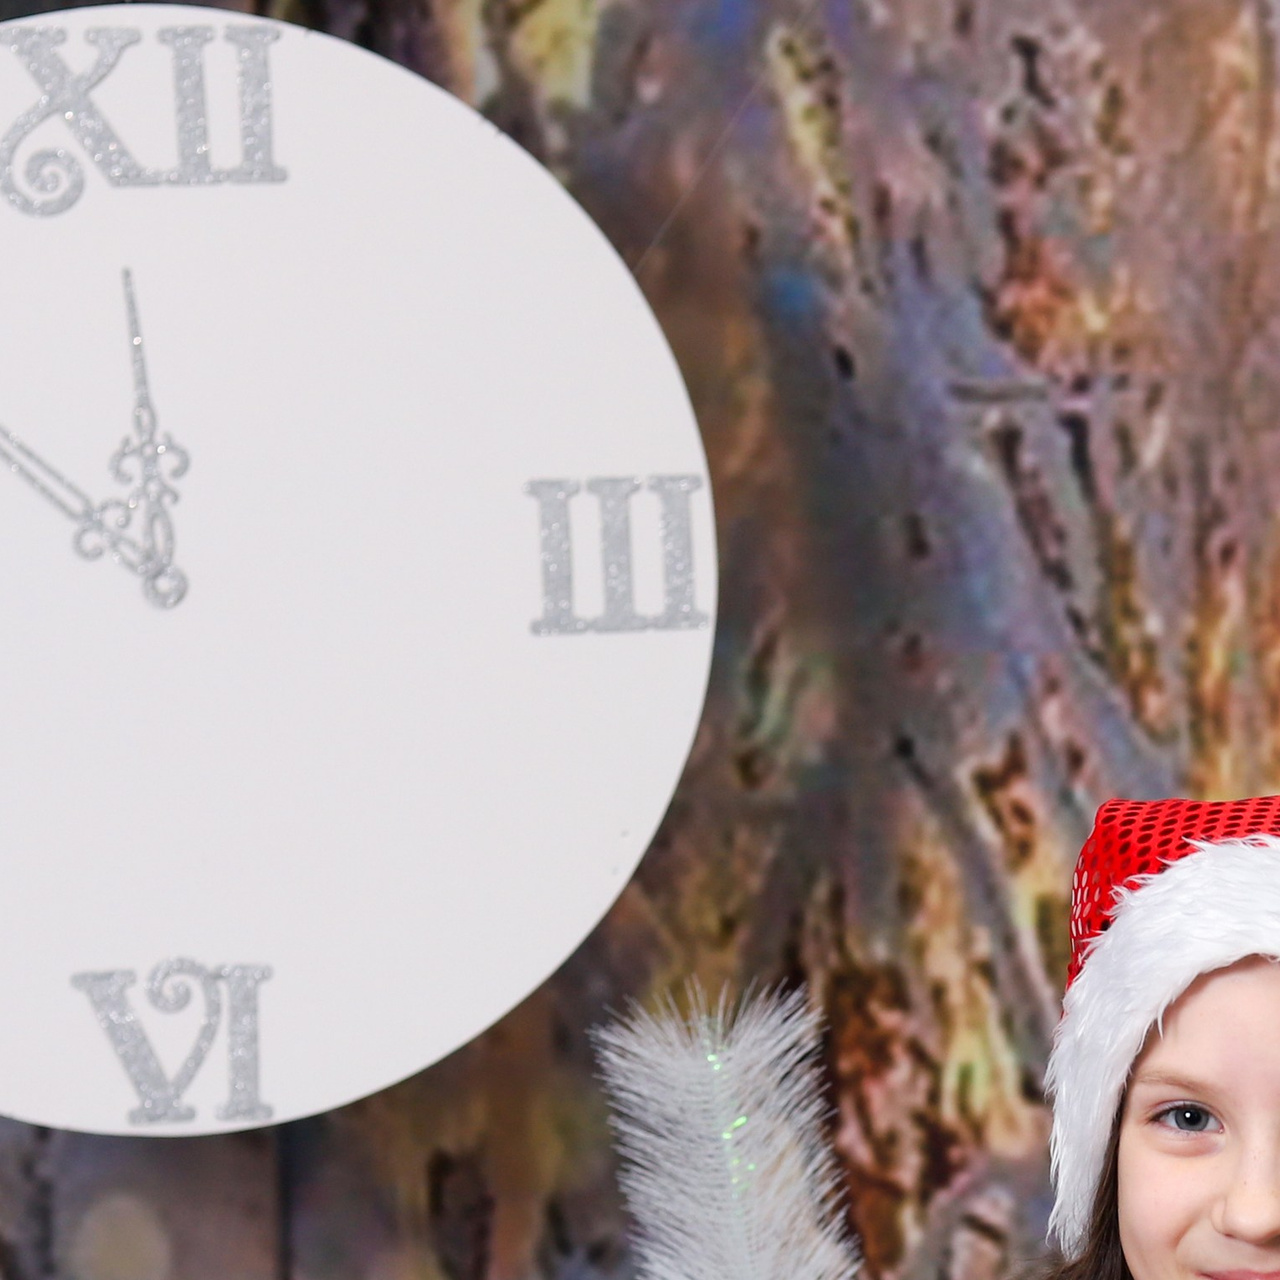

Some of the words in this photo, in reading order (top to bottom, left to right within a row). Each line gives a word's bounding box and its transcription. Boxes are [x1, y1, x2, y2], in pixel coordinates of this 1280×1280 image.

[0, 24, 289, 218] XII
[523, 474, 709, 636] III
[69, 957, 274, 1126] VI
